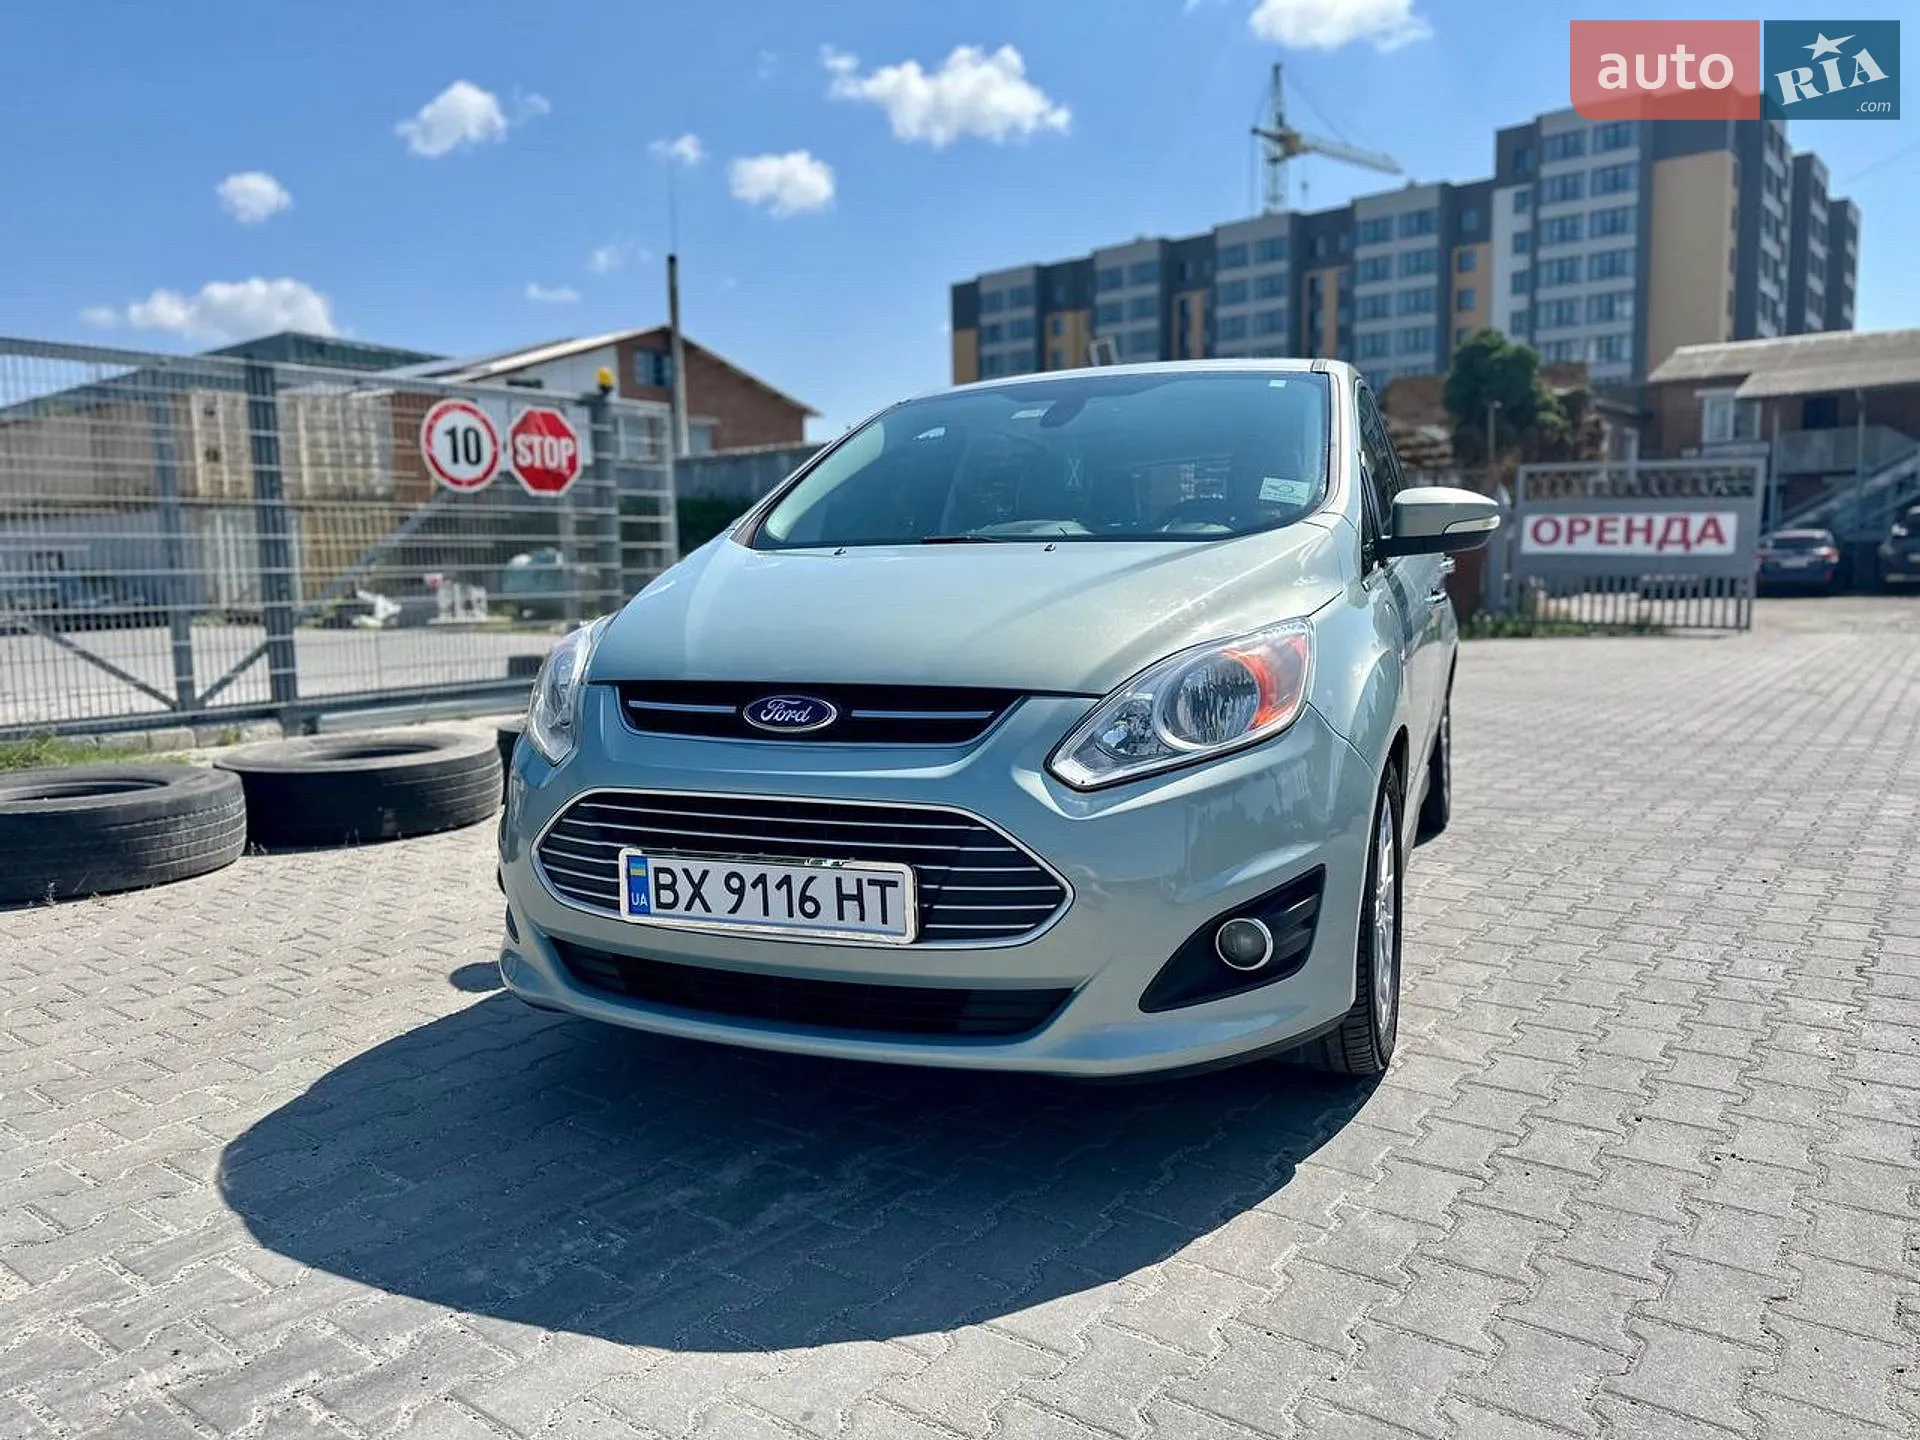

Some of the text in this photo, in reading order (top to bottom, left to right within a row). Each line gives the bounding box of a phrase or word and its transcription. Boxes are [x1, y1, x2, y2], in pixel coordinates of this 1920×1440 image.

[445, 426, 482, 466] 10
[515, 432, 574, 471] STOP
[1531, 513, 1727, 552] ОРЕНДА
[760, 699, 813, 722] Ford
[631, 892, 648, 906] UA
[653, 866, 898, 925] BX 9116 HT
